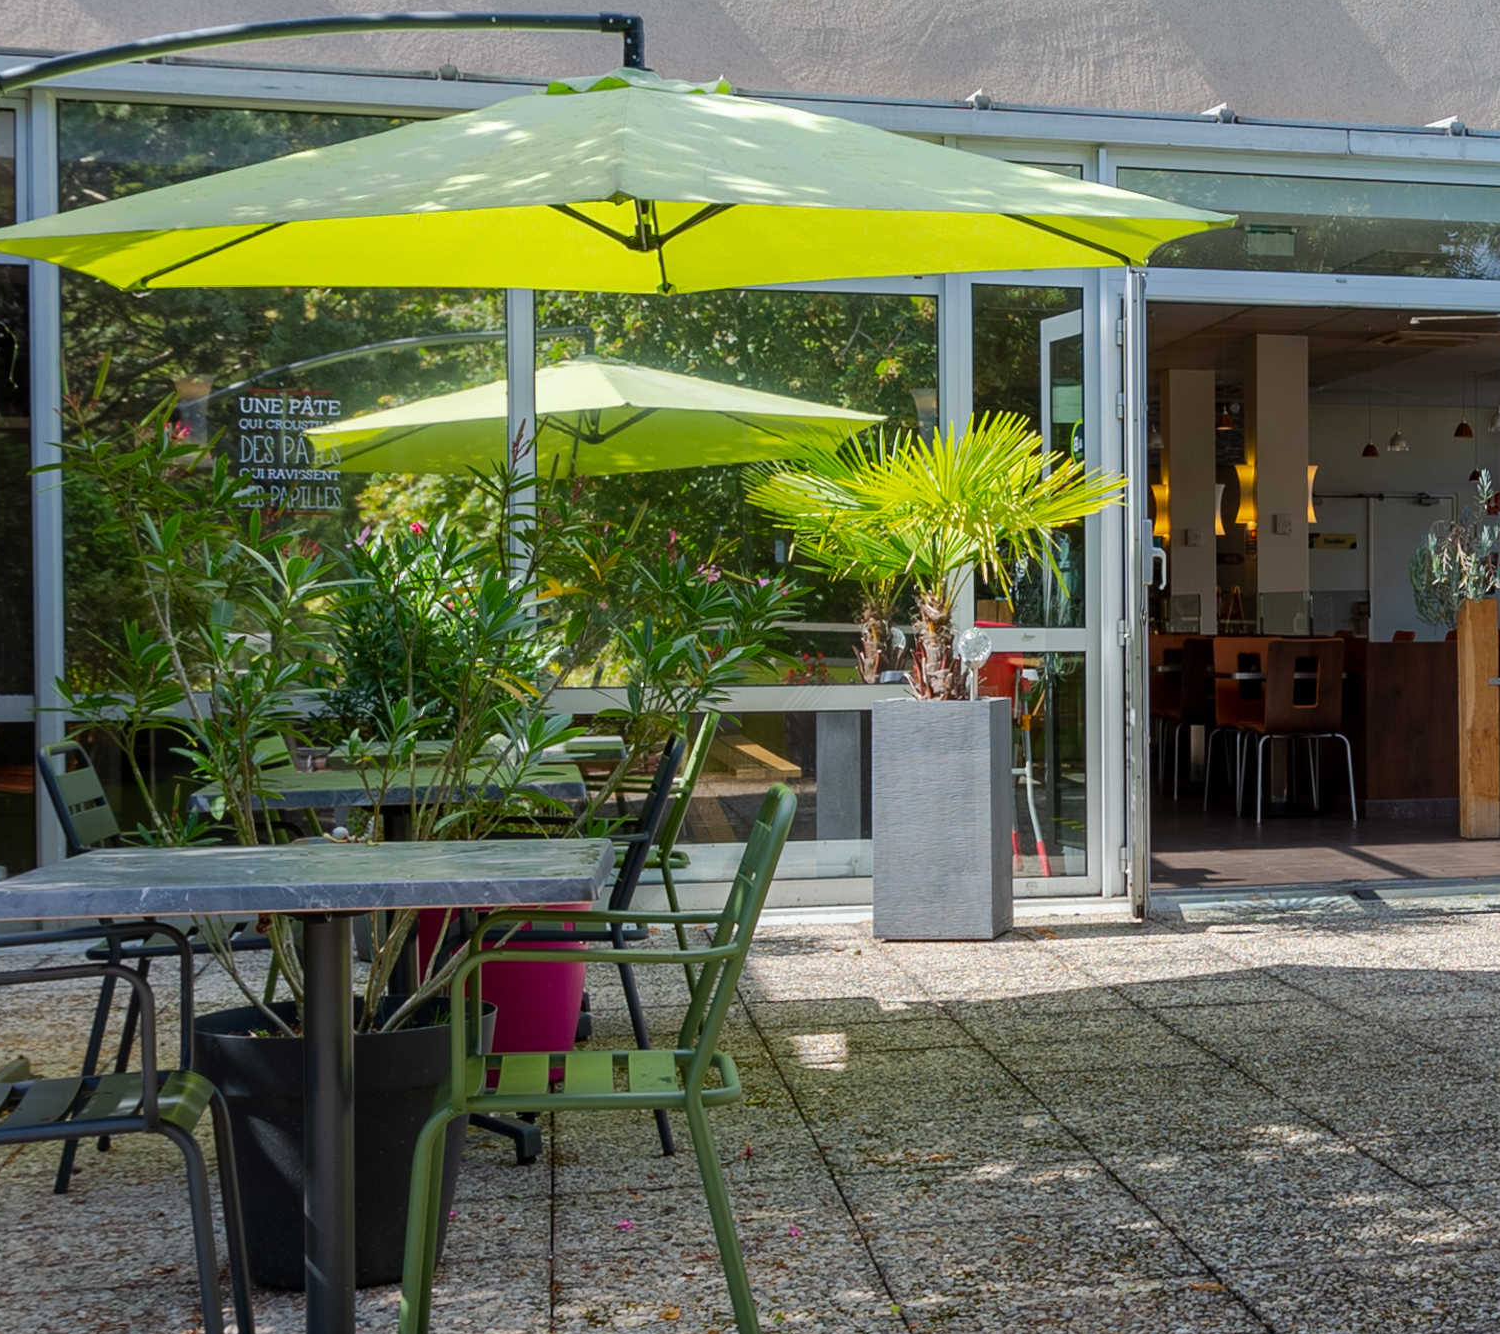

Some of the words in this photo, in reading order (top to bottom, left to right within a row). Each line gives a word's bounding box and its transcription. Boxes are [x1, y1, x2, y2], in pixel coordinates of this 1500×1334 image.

[238, 397, 284, 415] UNE
[288, 395, 341, 416] PÂTE
[238, 418, 263, 430] QUI
[265, 419, 340, 430] CROUSTI
[239, 434, 275, 464] DES
[283, 432, 341, 465] PÂTES
[267, 468, 341, 481] RAVISSENT
[270, 484, 342, 509] PAPILLES
